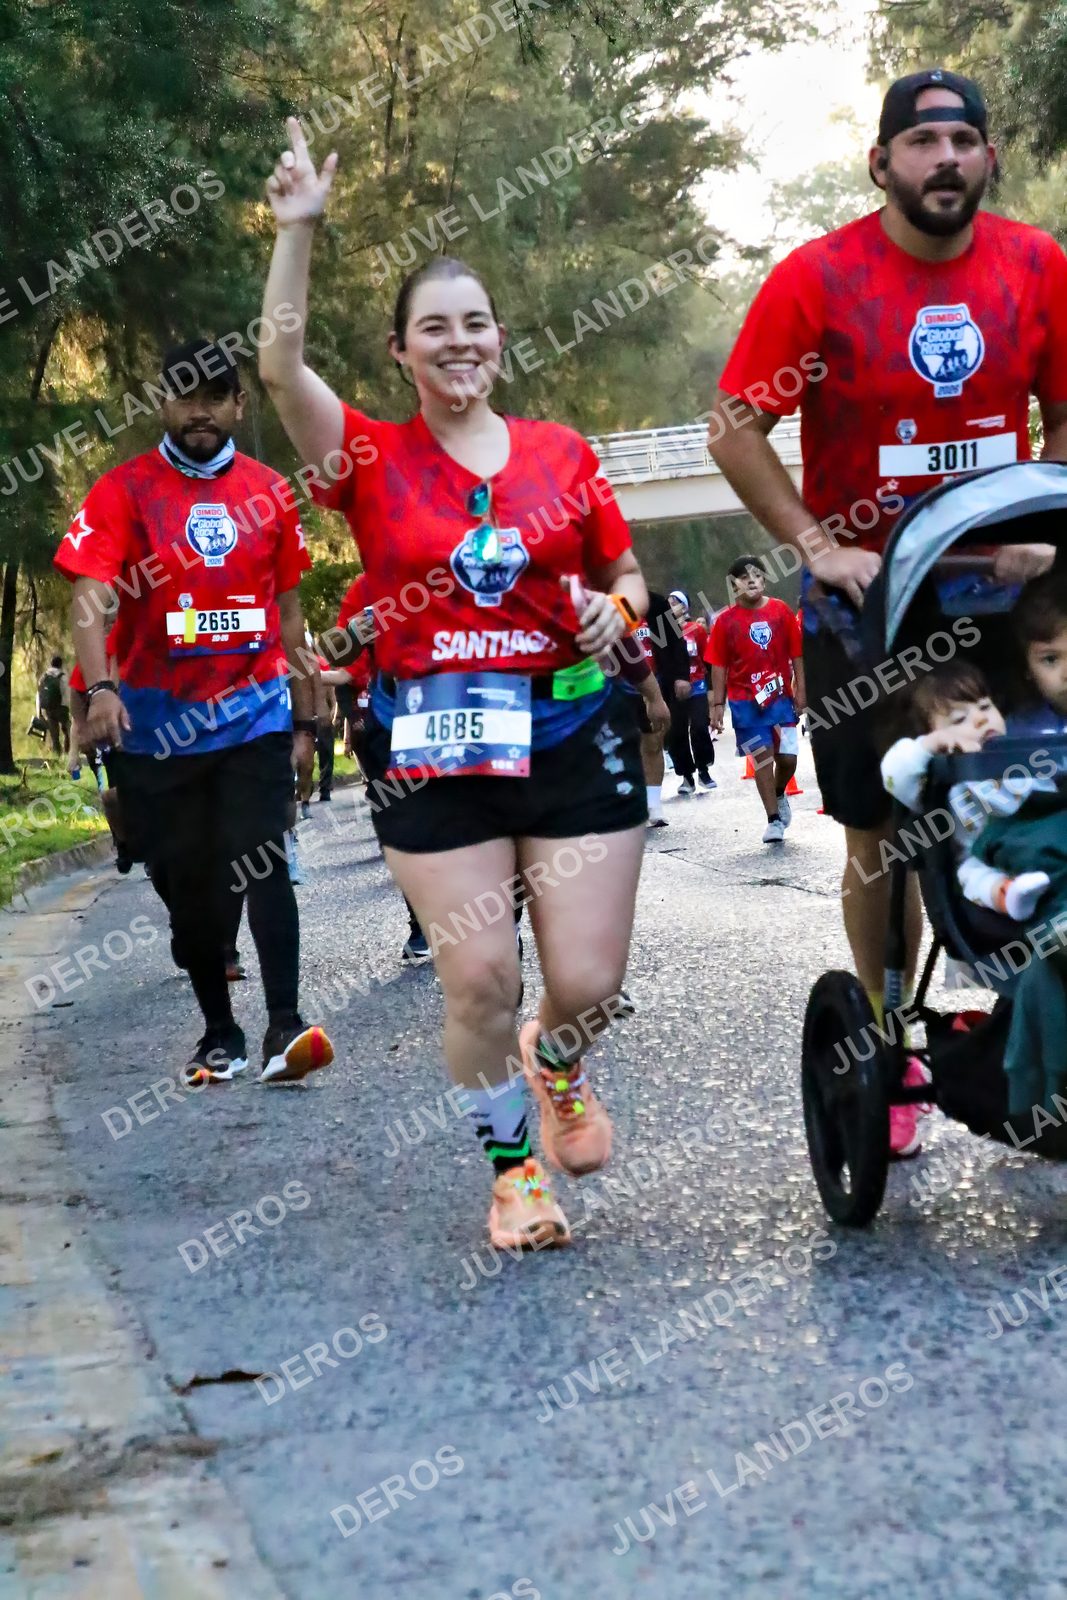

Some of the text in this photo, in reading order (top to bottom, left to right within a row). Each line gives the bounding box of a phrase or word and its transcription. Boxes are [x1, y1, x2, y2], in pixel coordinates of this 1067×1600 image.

[928, 441, 977, 472] 3011
[198, 611, 240, 632] 2655
[425, 711, 484, 741] 4685
